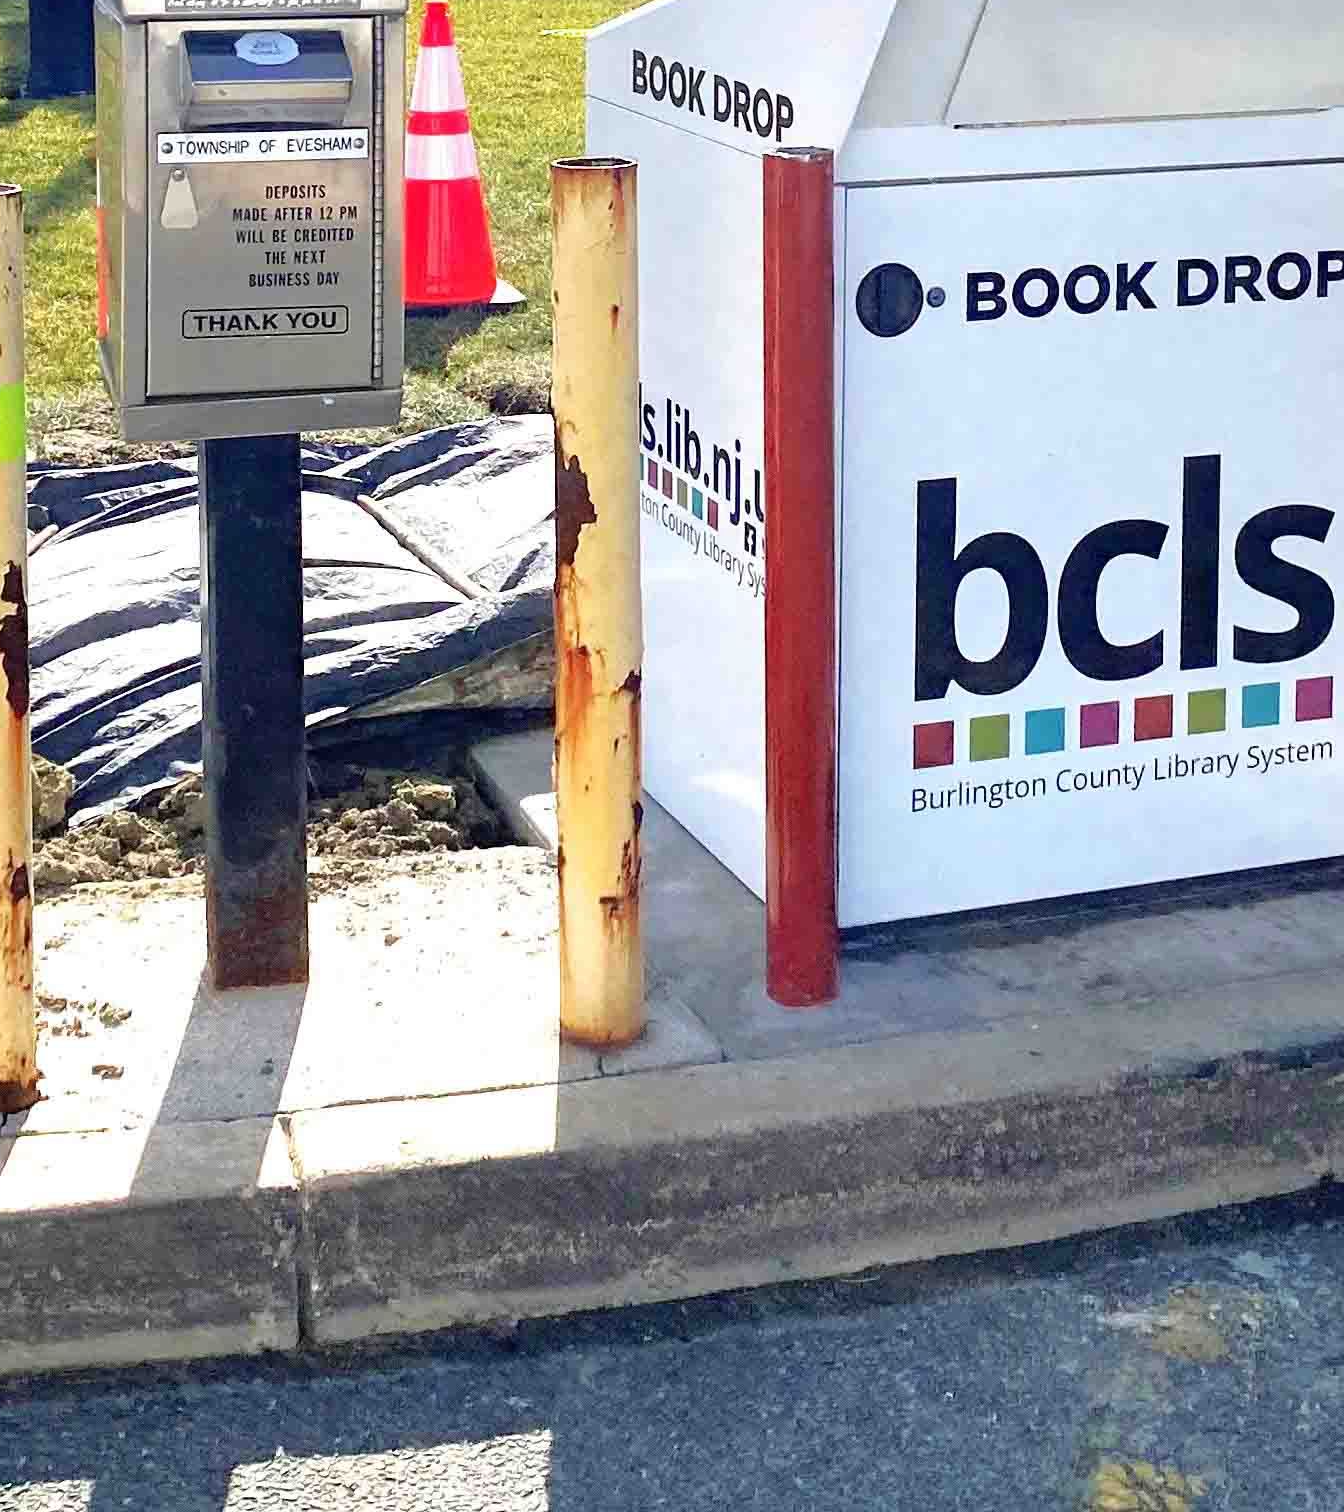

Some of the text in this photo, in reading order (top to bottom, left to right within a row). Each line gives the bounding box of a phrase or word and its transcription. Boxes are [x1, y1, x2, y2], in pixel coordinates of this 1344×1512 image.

[633, 49, 794, 142] BOOK DROP
[177, 136, 352, 156] TOWNSHIP OF EVESHAM
[265, 184, 326, 199] DEPOSITS
[232, 206, 357, 222] MADE AFTER 12 PM
[236, 227, 354, 244] WILL BE CREDITED
[264, 249, 326, 265] THE NEXT
[248, 271, 340, 288] BUSINESS DAY
[965, 260, 1158, 322] BOOK
[193, 311, 337, 333] THANK YOU
[661, 502, 702, 555] County
[704, 530, 745, 586] Library
[914, 454, 1336, 701] bcls
[911, 739, 1334, 813] Burlington County Library System
